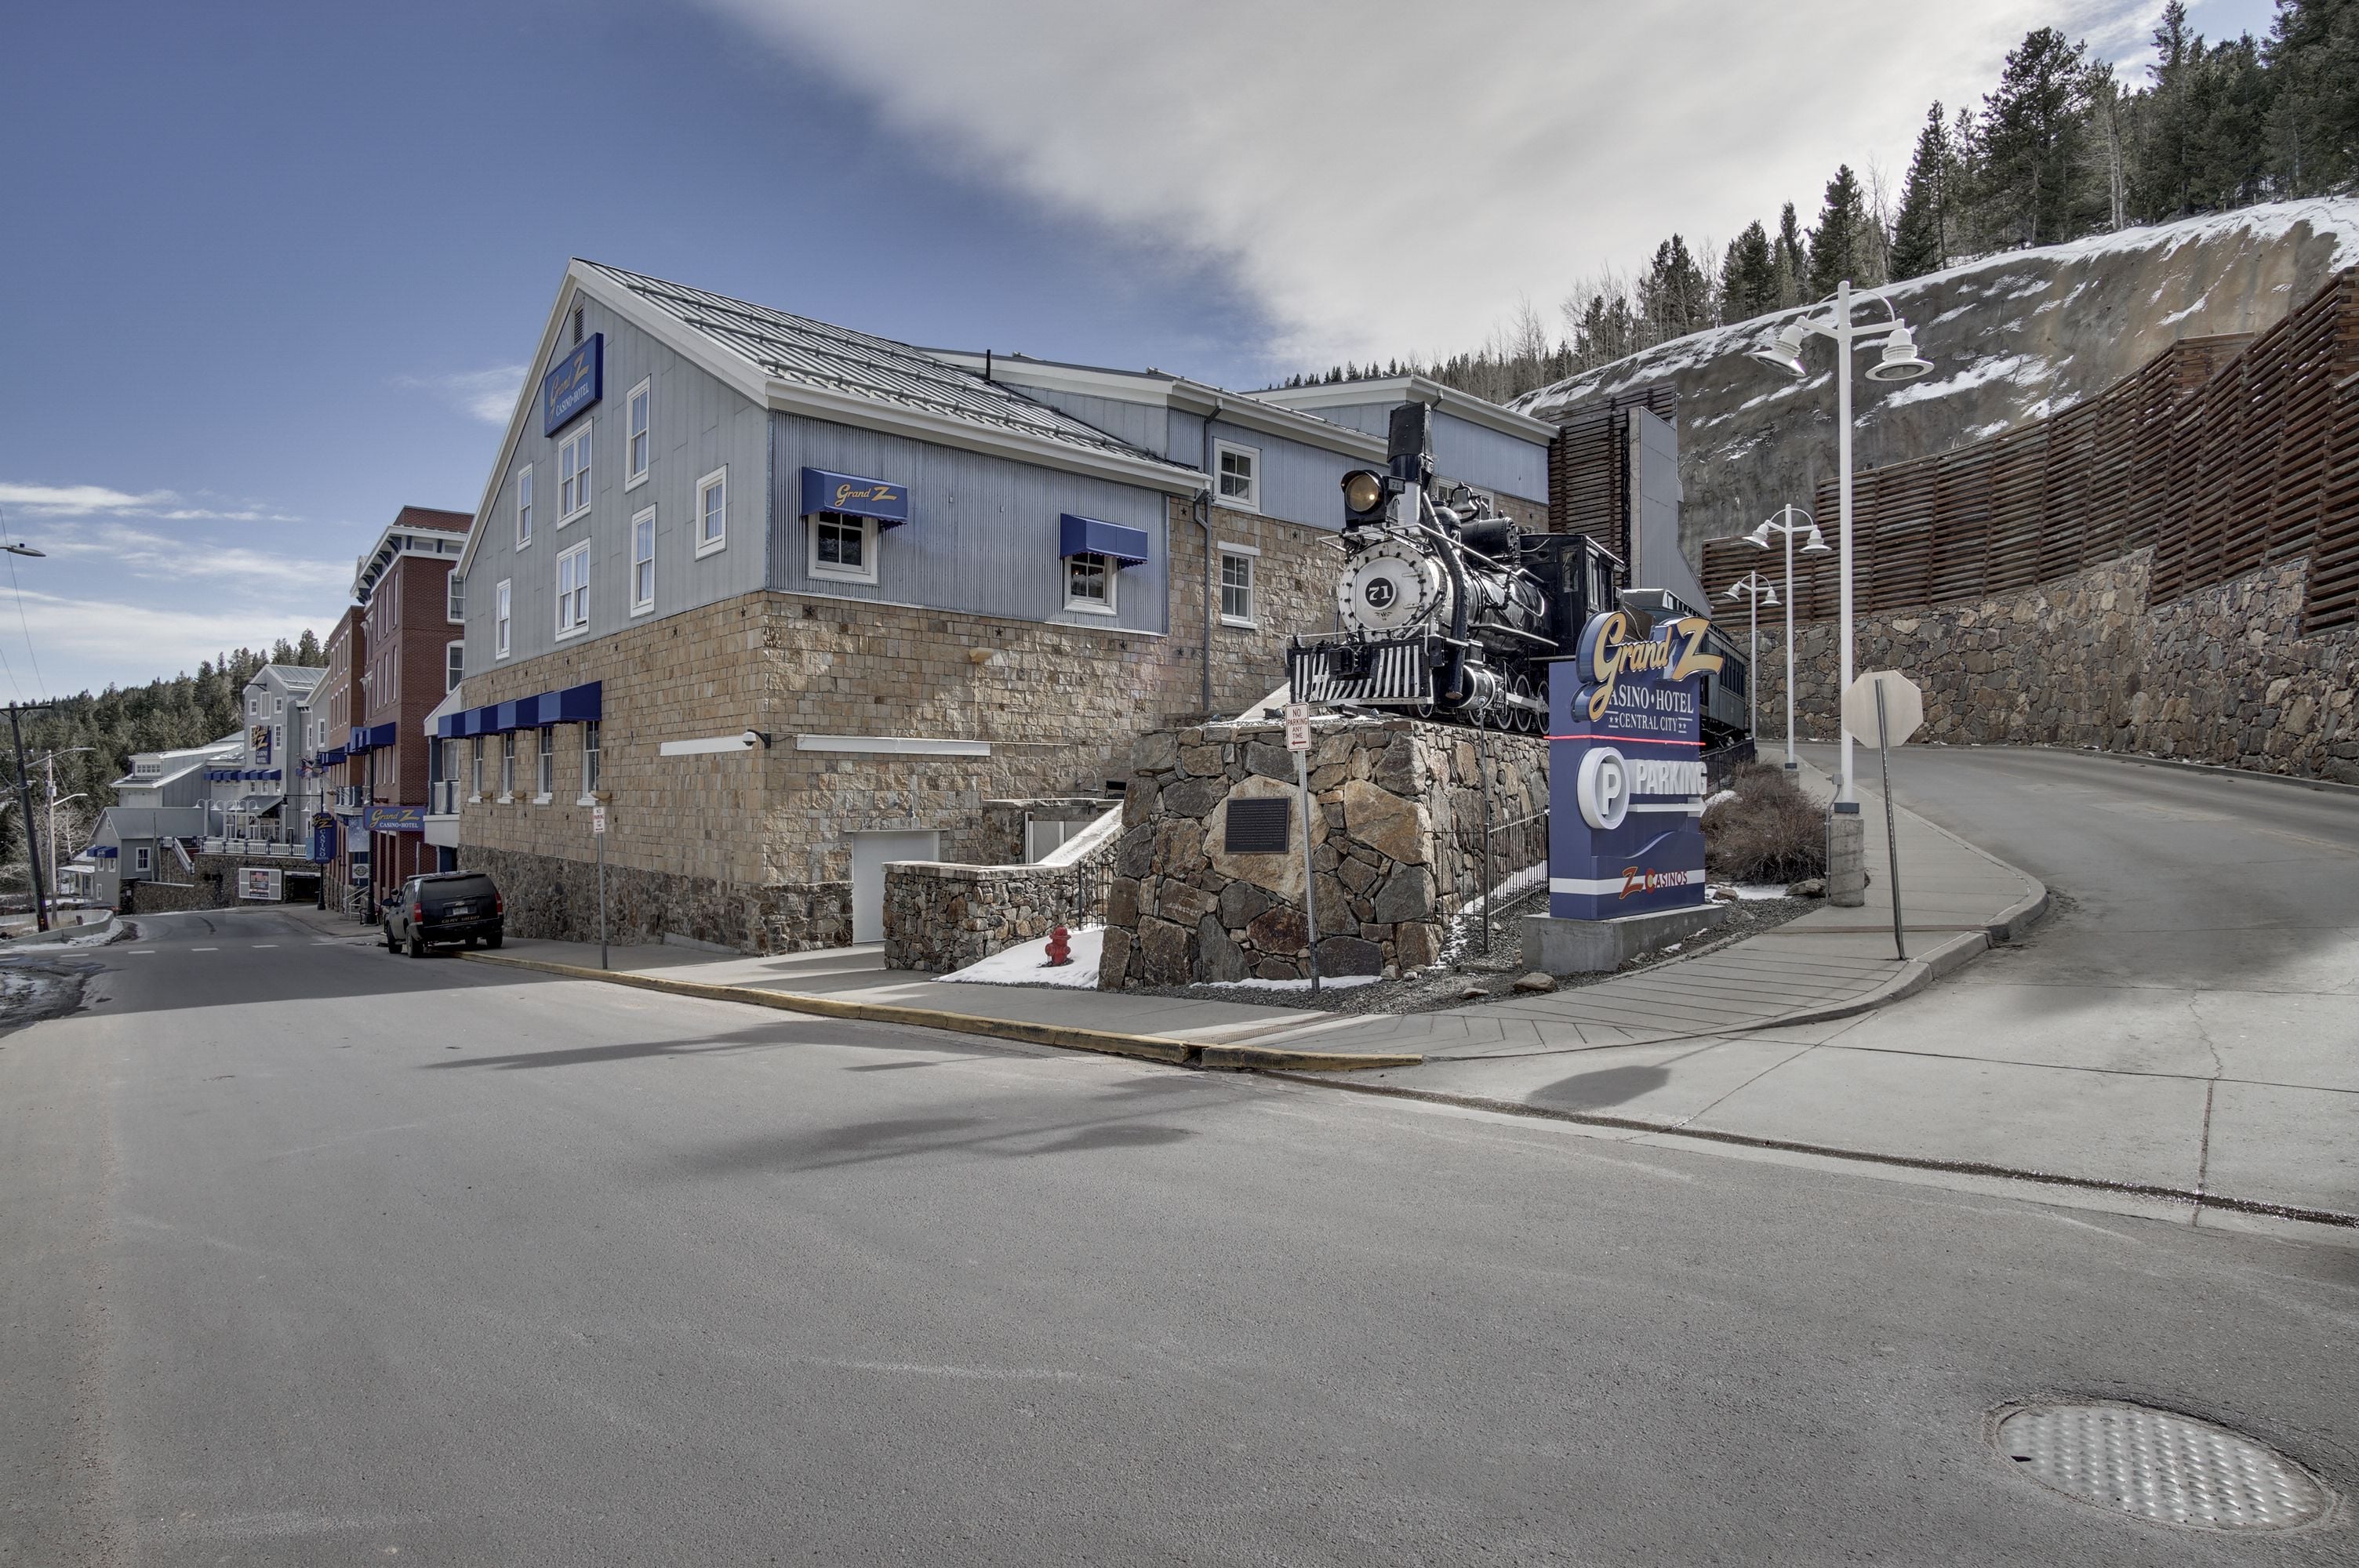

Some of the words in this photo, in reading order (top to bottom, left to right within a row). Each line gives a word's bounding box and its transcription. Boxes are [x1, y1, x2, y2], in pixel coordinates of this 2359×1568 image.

[549, 368, 572, 423] Grand
[571, 351, 590, 390] Z
[834, 484, 872, 506] Grand
[871, 486, 897, 502] Z
[1369, 586, 1390, 601] 71
[1589, 611, 1672, 721] Grand
[1671, 617, 1725, 681] Z
[1608, 684, 1649, 709] ASINO
[1288, 717, 1308, 726] PARKING
[1292, 708, 1301, 717] NO
[1619, 712, 1659, 731] CENTRAL
[1659, 716, 1678, 731] CITY
[1636, 760, 1707, 794] PARKING
[1601, 763, 1622, 815] P
[369, 809, 399, 828] Grand
[398, 809, 420, 822] Z
[1619, 866, 1644, 899] Z
[1645, 867, 1688, 894] CASINOS
